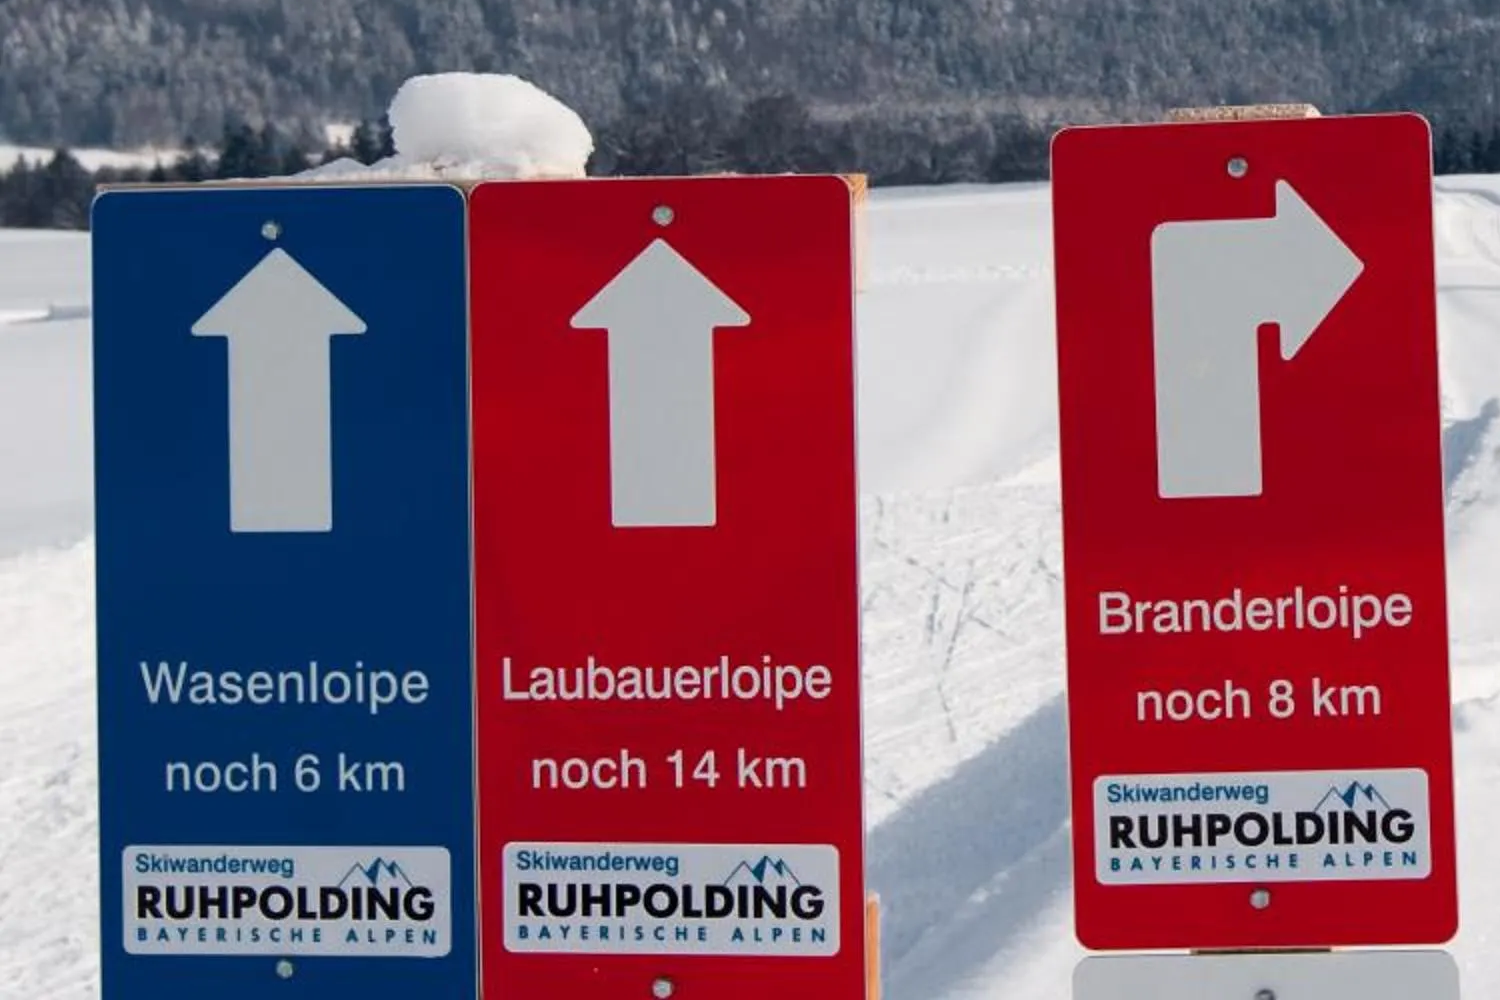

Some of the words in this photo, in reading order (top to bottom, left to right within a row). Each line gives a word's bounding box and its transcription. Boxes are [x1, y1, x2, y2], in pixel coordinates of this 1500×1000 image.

[1099, 585, 1412, 639] Branderloipe
[140, 661, 429, 714] Wasenloipe
[503, 656, 832, 710] Laubauerloipe
[1137, 680, 1251, 721] noch
[1268, 680, 1295, 718] 8
[1313, 678, 1381, 716] km
[165, 753, 278, 792] noch
[294, 755, 320, 792] 6
[339, 753, 405, 791] km
[532, 749, 647, 789] noch
[666, 750, 719, 788] 14
[738, 748, 806, 788] km
[1107, 783, 1269, 804] Skiwanderweg
[1110, 809, 1414, 849] RUHPOLDING
[135, 852, 295, 879] Skiwanderweg
[516, 850, 679, 877] Skiwanderweg
[1111, 854, 1298, 872] BAYERISCHE
[1323, 851, 1417, 867] ALPEN
[137, 885, 435, 921] RUHPOLDING
[517, 882, 824, 920] RUHPOLDING
[137, 928, 322, 944] BAYERISCHE
[346, 928, 436, 945] ALPEN
[518, 925, 707, 941] BAYERISCHE
[731, 925, 826, 943] ALPEN
